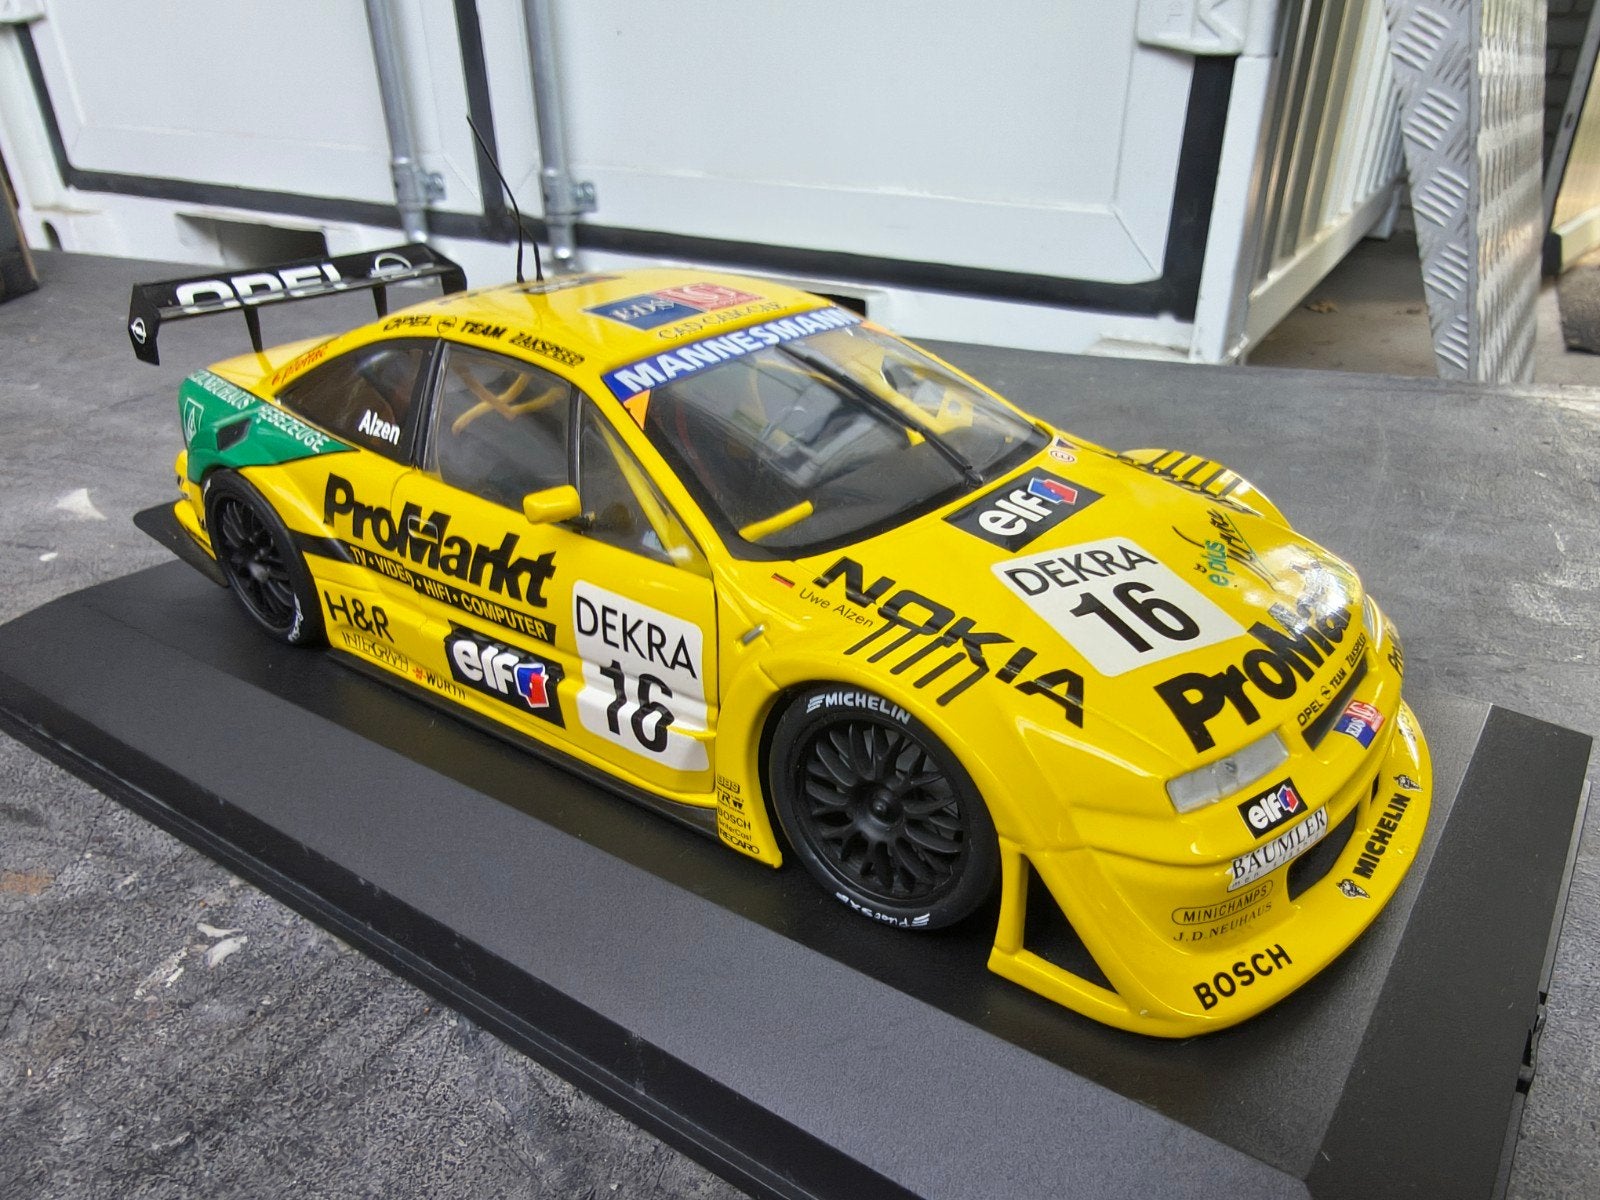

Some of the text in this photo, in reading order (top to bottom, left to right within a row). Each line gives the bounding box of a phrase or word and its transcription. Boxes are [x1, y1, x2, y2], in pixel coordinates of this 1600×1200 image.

[461, 320, 507, 340] TEAM
[614, 307, 862, 394] MANNESMANN
[359, 408, 401, 446] Alzen
[323, 472, 557, 608] ProMarkt
[978, 489, 1053, 536] elf
[350, 546, 368, 566] TV
[423, 576, 453, 604] HIFI
[460, 594, 549, 641] COMPUTER
[1003, 545, 1159, 597] DEKRA
[324, 590, 396, 644] H&R
[799, 587, 875, 628] Uwe Alzen
[1069, 581, 1201, 654] 16
[576, 594, 698, 681] DEKRA
[812, 556, 1084, 729] NOKIA
[452, 639, 520, 696] elf
[599, 659, 675, 753] 16
[825, 691, 912, 725] MICHELIN
[1297, 700, 1324, 727] OPEL
[1329, 668, 1348, 690] TEAM
[1248, 792, 1283, 829] elf
[1352, 792, 1412, 881] MICHELIN
[1183, 884, 1268, 923] MINICHAMPS
[1193, 943, 1293, 1011] BOSCH
